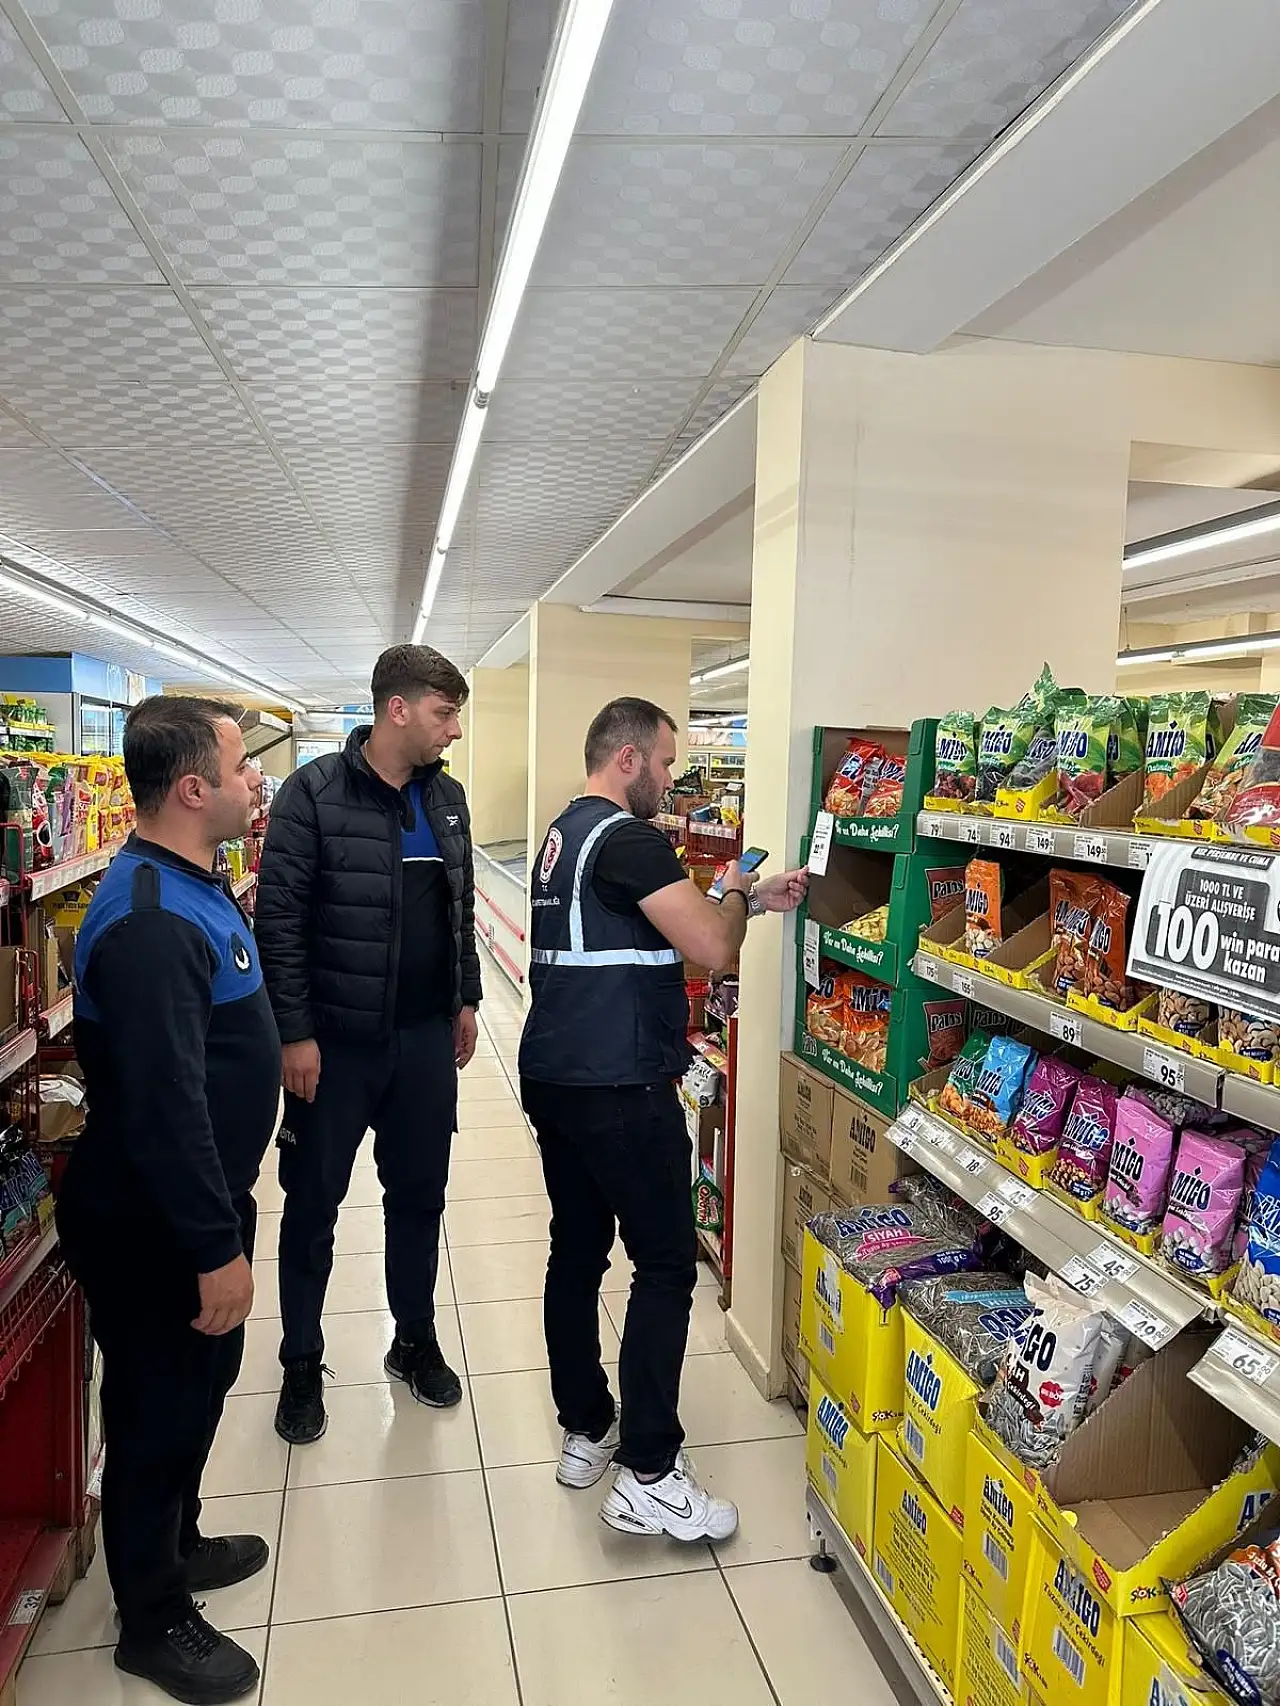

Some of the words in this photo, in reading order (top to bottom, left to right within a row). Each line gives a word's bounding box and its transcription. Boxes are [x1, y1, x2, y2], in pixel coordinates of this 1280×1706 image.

[966, 828, 977, 842] 74
[999, 832, 1011, 848] 94
[1037, 836, 1050, 850] 149
[1086, 844, 1102, 858] 149
[1248, 854, 1271, 866] CUMA
[1199, 878, 1220, 895] 1000
[1221, 883, 1231, 897] TL
[1233, 885, 1244, 900] VE
[1185, 890, 1210, 910] ÜZERİ
[1211, 898, 1256, 922] ALIŞVERİŞE
[1154, 902, 1219, 971] 100
[1220, 931, 1244, 955] win
[1245, 938, 1280, 963] para
[1223, 950, 1267, 984] kazan
[1062, 1025, 1076, 1042] 89
[1160, 1065, 1176, 1087] 95
[966, 1159, 980, 1172] 18
[988, 1205, 1004, 1222] 95
[1102, 1260, 1125, 1277] 45
[1074, 1273, 1095, 1292] 75
[1232, 1354, 1261, 1375] 65
